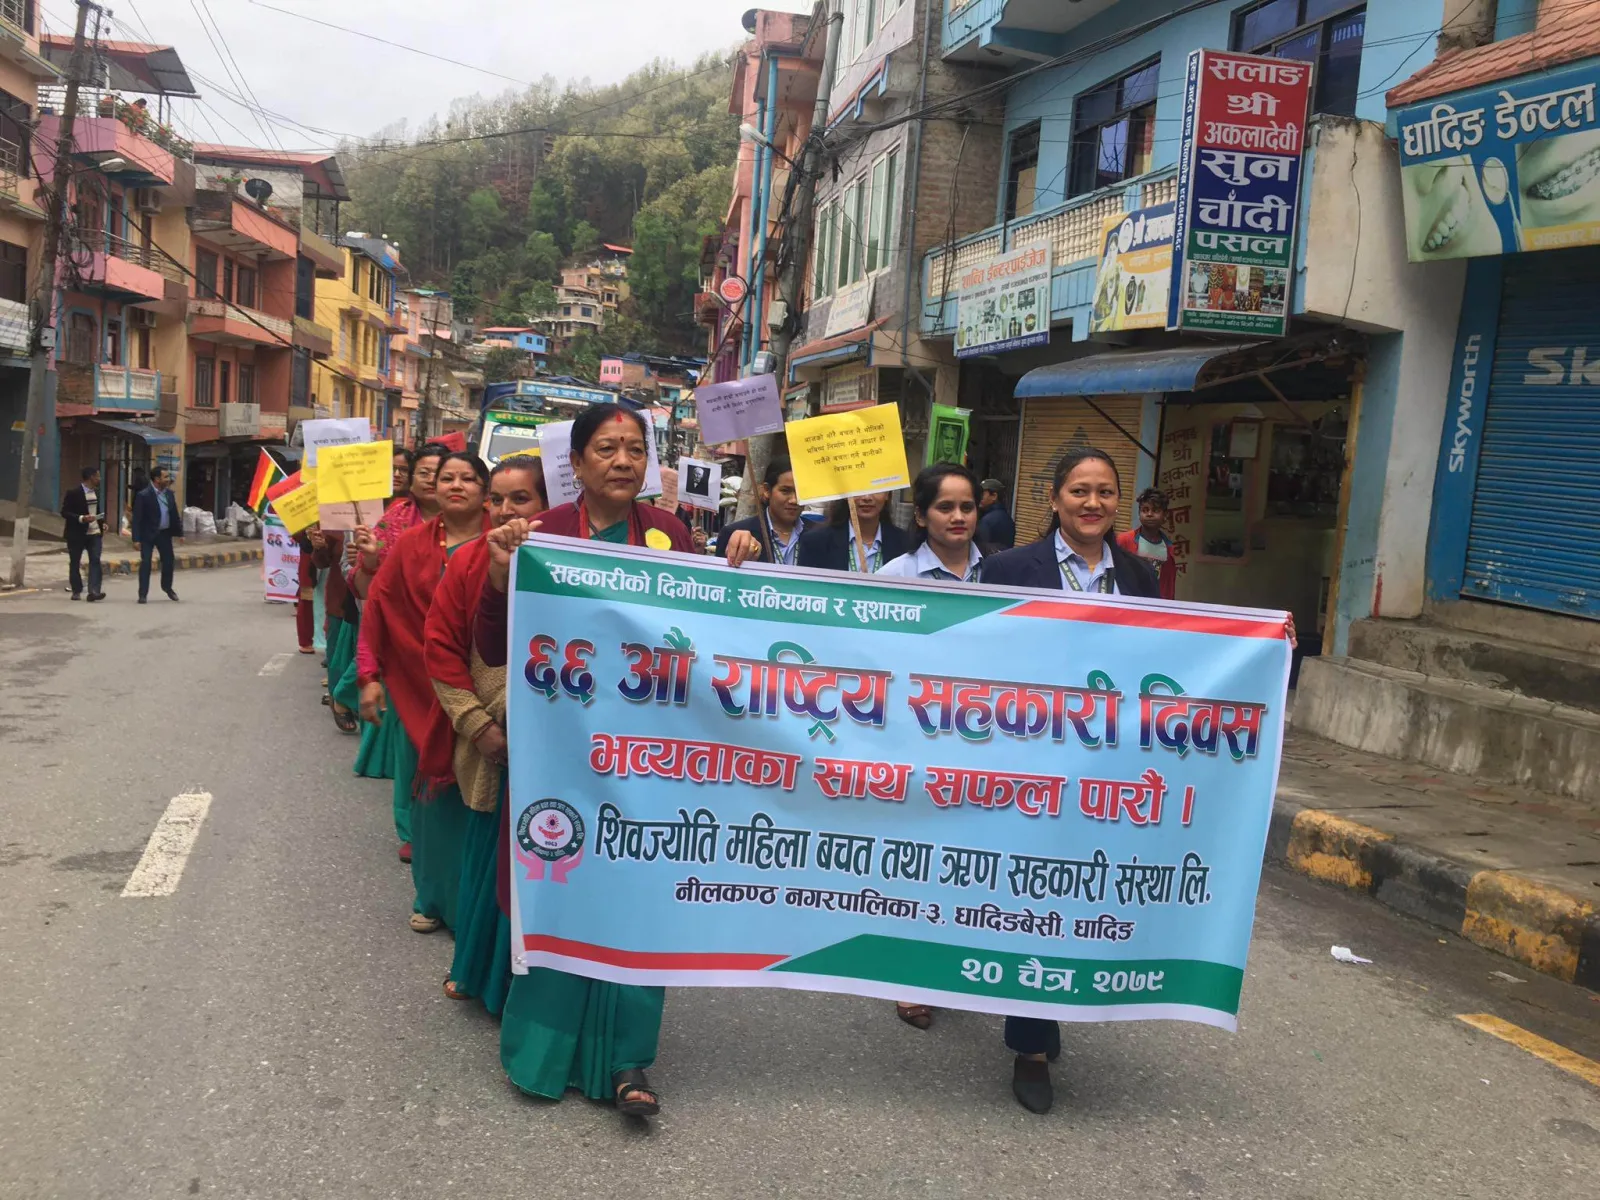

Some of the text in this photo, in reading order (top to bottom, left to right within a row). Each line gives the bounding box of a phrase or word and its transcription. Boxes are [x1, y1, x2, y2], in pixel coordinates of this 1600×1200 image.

[1208, 57, 1304, 86] सलाङ
[1227, 91, 1281, 117] श्री
[1402, 82, 1597, 157] धादिङ डेन्टल
[1203, 120, 1299, 151] अकलादेवी
[1200, 149, 1296, 186] सुन
[1198, 188, 1292, 233] चाँदी
[1194, 230, 1288, 254] पसल
[1449, 333, 1482, 474] Skyworth
[738, 585, 828, 614] स्वनियमन
[833, 598, 847, 617] र
[524, 633, 595, 705] ६६
[709, 641, 893, 742] राष्ट्रिय
[907, 669, 1124, 748] सहकारी
[1137, 672, 1268, 761] दिवस
[589, 732, 803, 790] भव्यताका
[813, 757, 912, 802] साथ
[924, 765, 1068, 817] सफल
[594, 801, 1212, 907] शिवज्योति महिला बचत तथा ऋण सहकारी संस्था लि.
[674, 876, 779, 905] नीलकण्ठ
[1073, 913, 1136, 944] धादिङ
[960, 957, 1166, 995] २० चैत्र, २०७९
